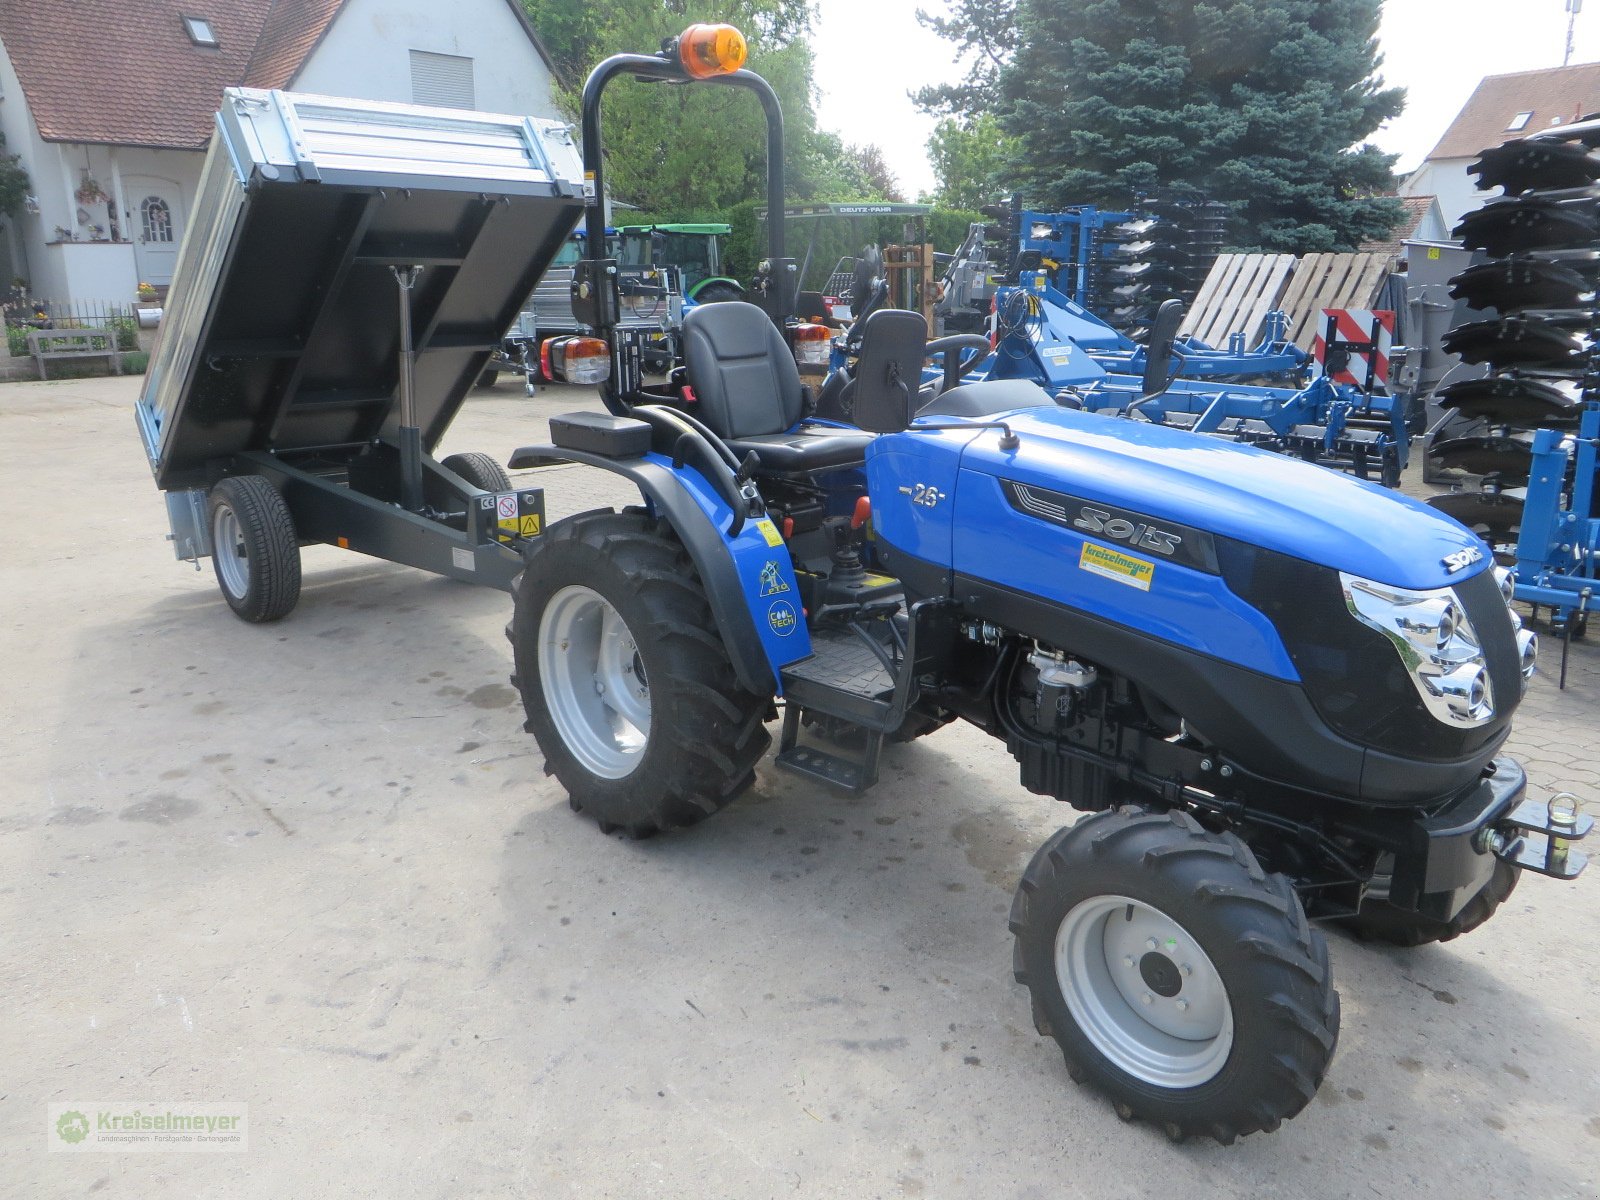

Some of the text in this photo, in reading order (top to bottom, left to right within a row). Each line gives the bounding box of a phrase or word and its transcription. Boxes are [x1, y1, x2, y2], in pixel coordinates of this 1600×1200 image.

[839, 206, 892, 214] DEUTZ-FAHR
[768, 583, 788, 595] PTO
[771, 617, 794, 629] TECH
